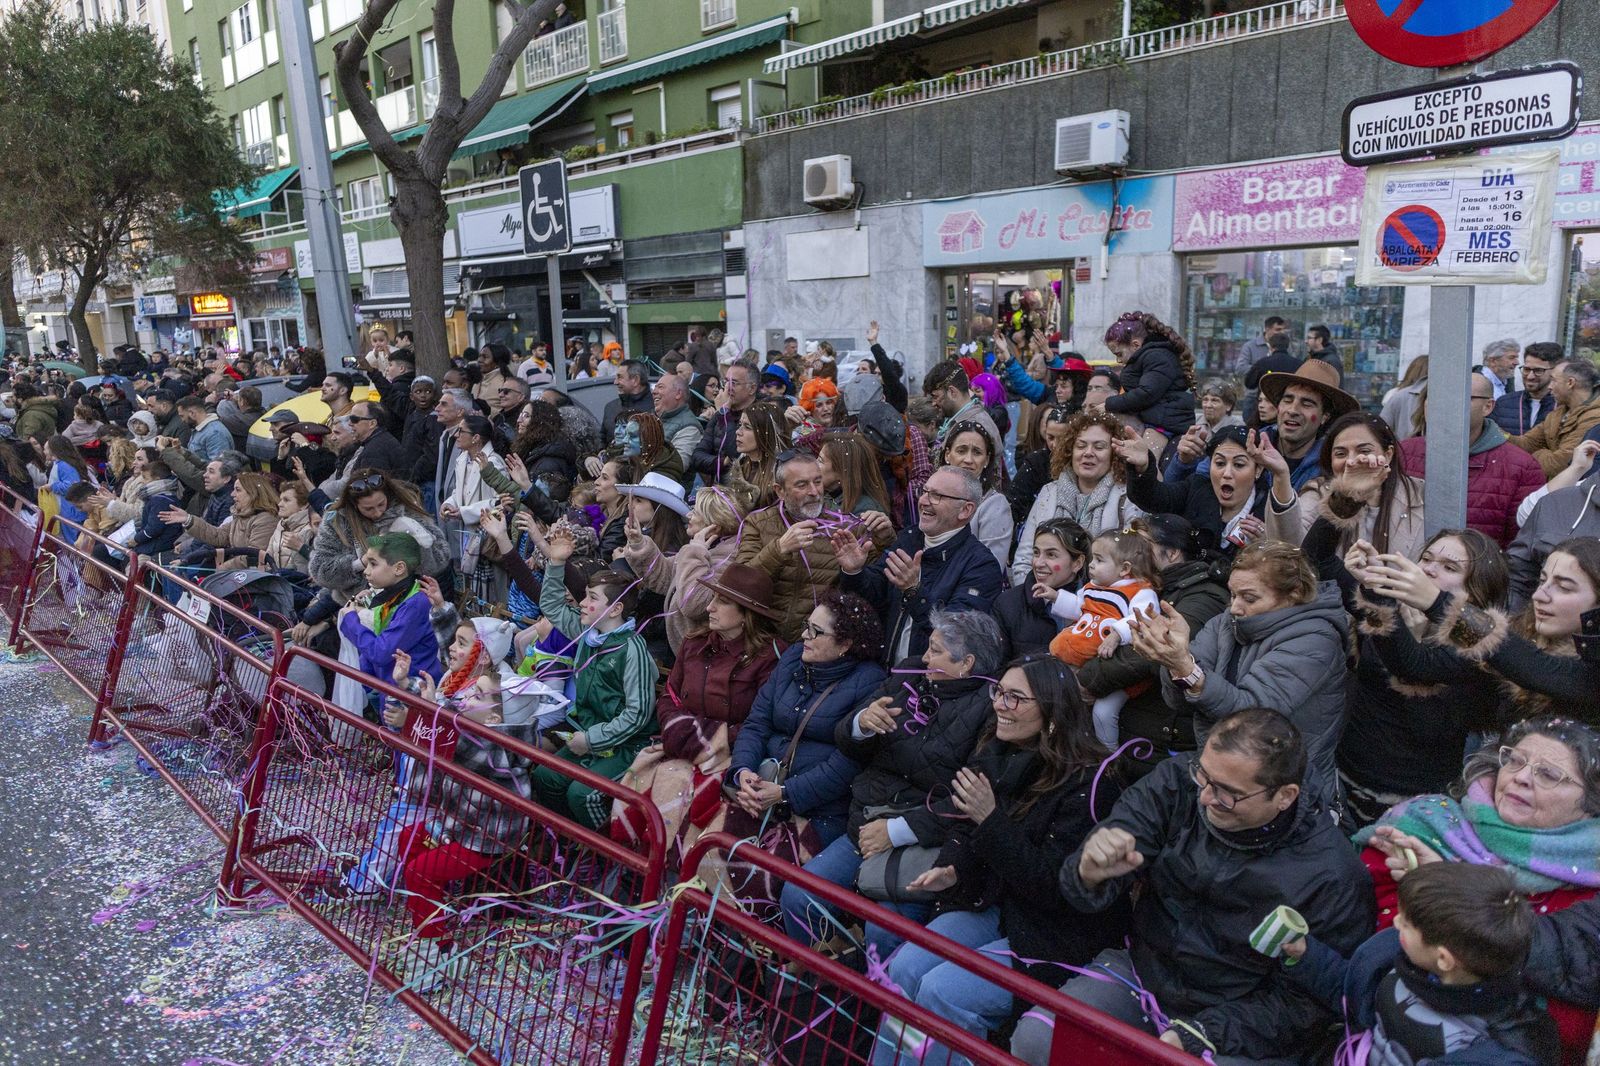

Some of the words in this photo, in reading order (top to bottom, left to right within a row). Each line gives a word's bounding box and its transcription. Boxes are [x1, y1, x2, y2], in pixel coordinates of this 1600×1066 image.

[1415, 86, 1482, 111] EXCEPTO
[1357, 112, 1434, 138] VEHÍCULOS
[1440, 110, 1458, 124] DE
[1464, 94, 1550, 121] PERSONAS
[1352, 138, 1381, 156] CON
[1386, 124, 1465, 150] MOVILIDAD
[1471, 112, 1553, 136] REDUCIDA
[1243, 174, 1340, 204] Bazar
[1505, 190, 1523, 201] 13
[500, 213, 522, 239] Alga
[999, 208, 1048, 248] Mi
[1186, 198, 1361, 238] Alimentaci
[1504, 211, 1522, 221] 16
[1436, 244, 1443, 255] Y
[1469, 231, 1512, 249] MES
[1374, 256, 1440, 267] LIMPIEZA
[1456, 251, 1520, 263] FEBRERO
